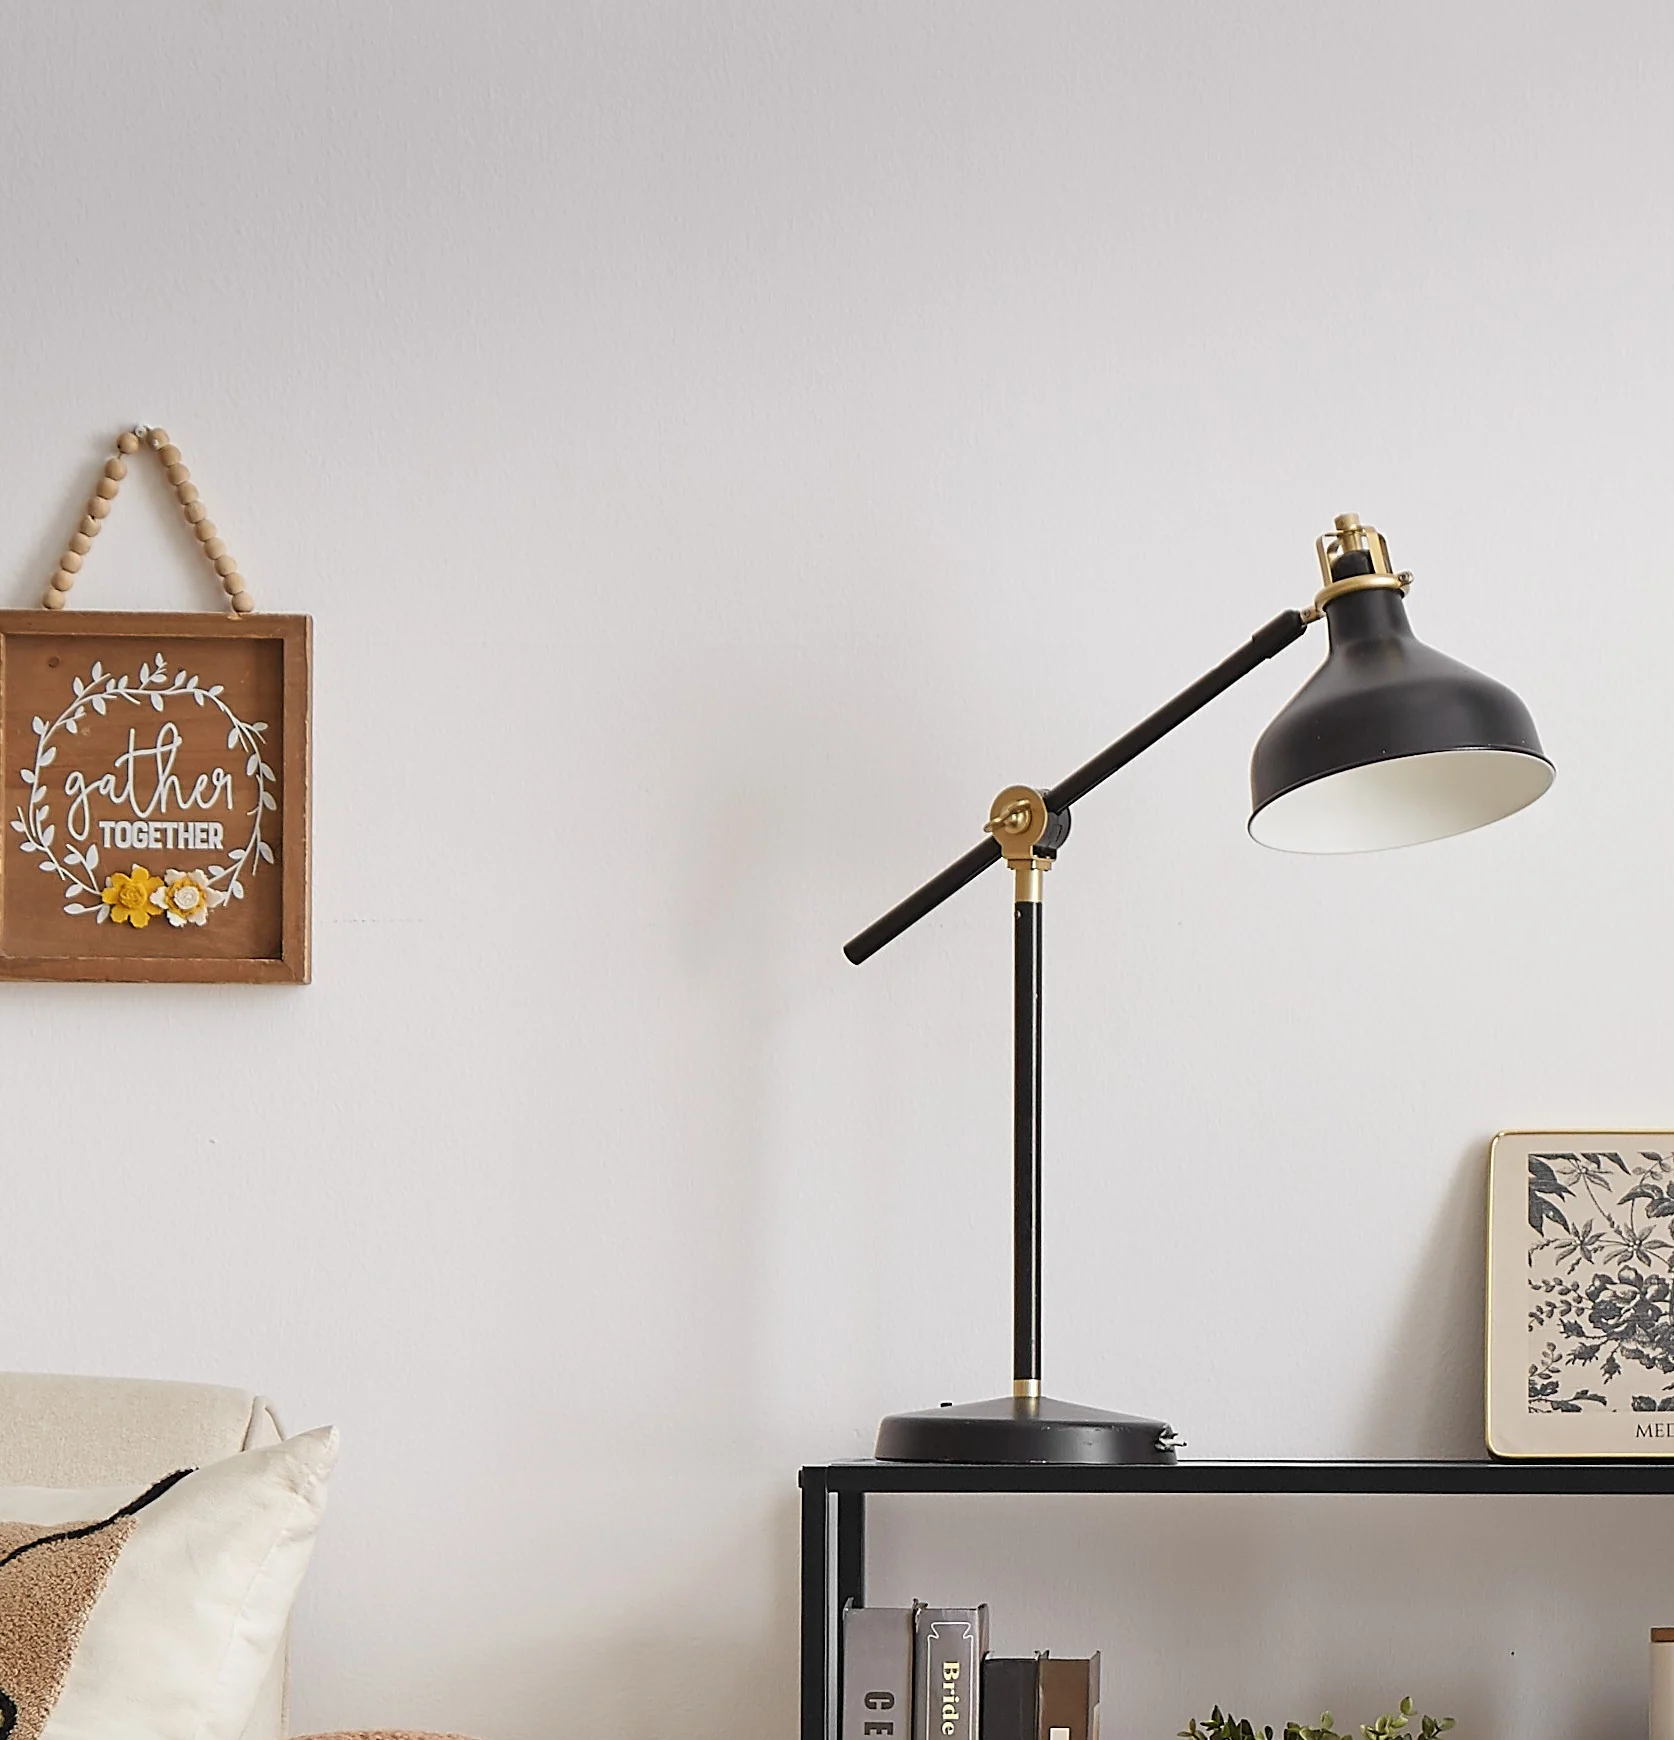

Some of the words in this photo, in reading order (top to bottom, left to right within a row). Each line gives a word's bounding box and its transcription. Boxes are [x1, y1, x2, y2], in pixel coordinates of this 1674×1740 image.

[64, 722, 235, 841] gather
[99, 820, 224, 850] TOGETHER
[941, 1661, 960, 1736] Bride
